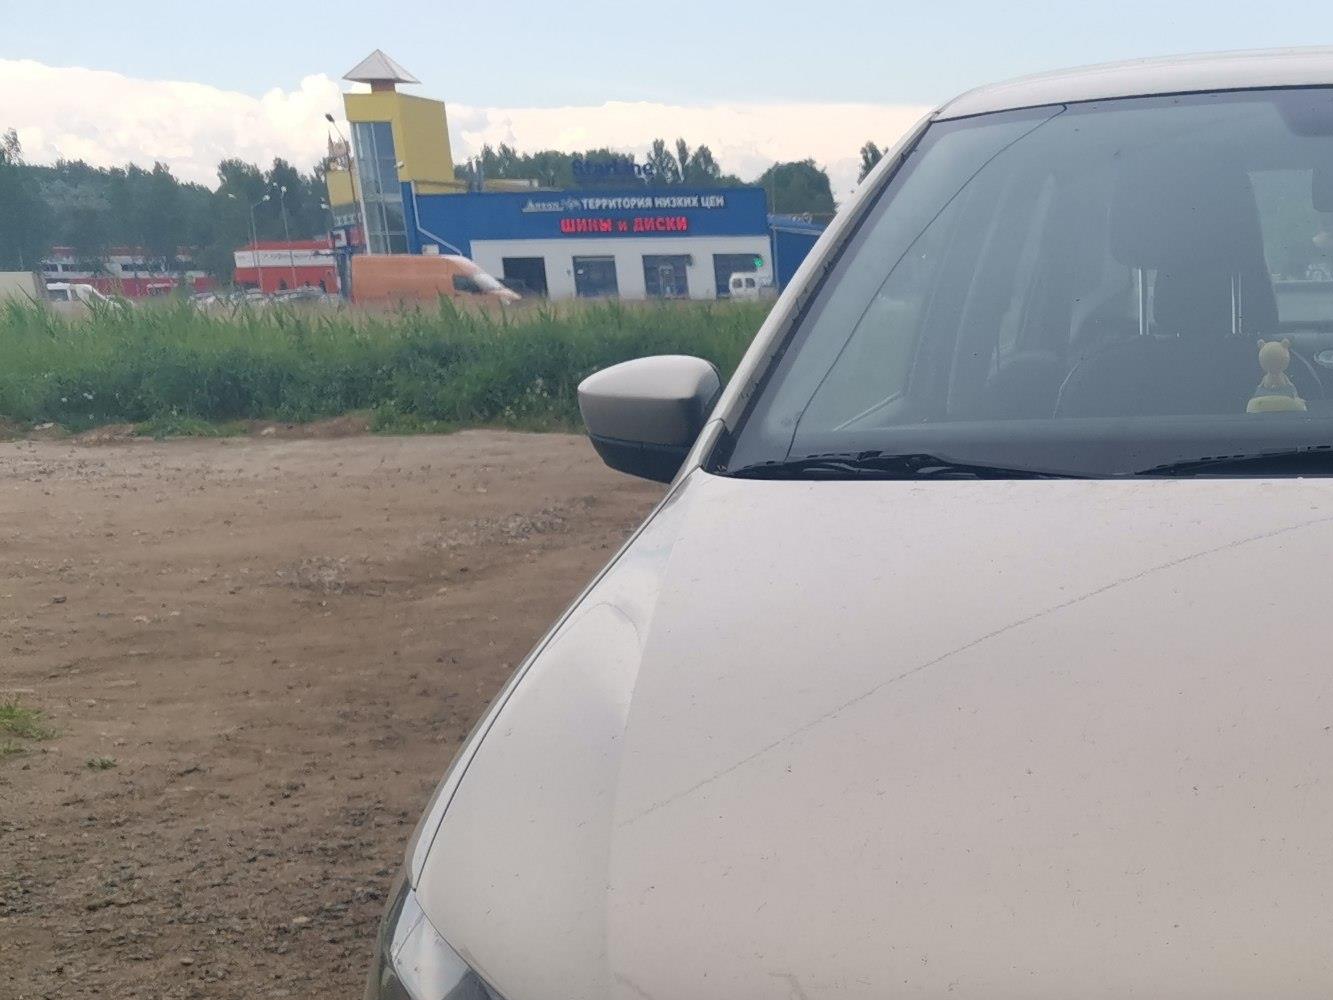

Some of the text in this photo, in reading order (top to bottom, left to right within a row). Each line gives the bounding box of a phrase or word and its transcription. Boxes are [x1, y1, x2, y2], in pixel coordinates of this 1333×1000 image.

[581, 198, 652, 210] ТЕРРИТОРИЯ
[654, 196, 699, 208] НИЗКИХ
[700, 195, 725, 209] ЦЕН
[560, 218, 613, 233] ШИНЫ
[632, 216, 689, 232] ДИСКИ
